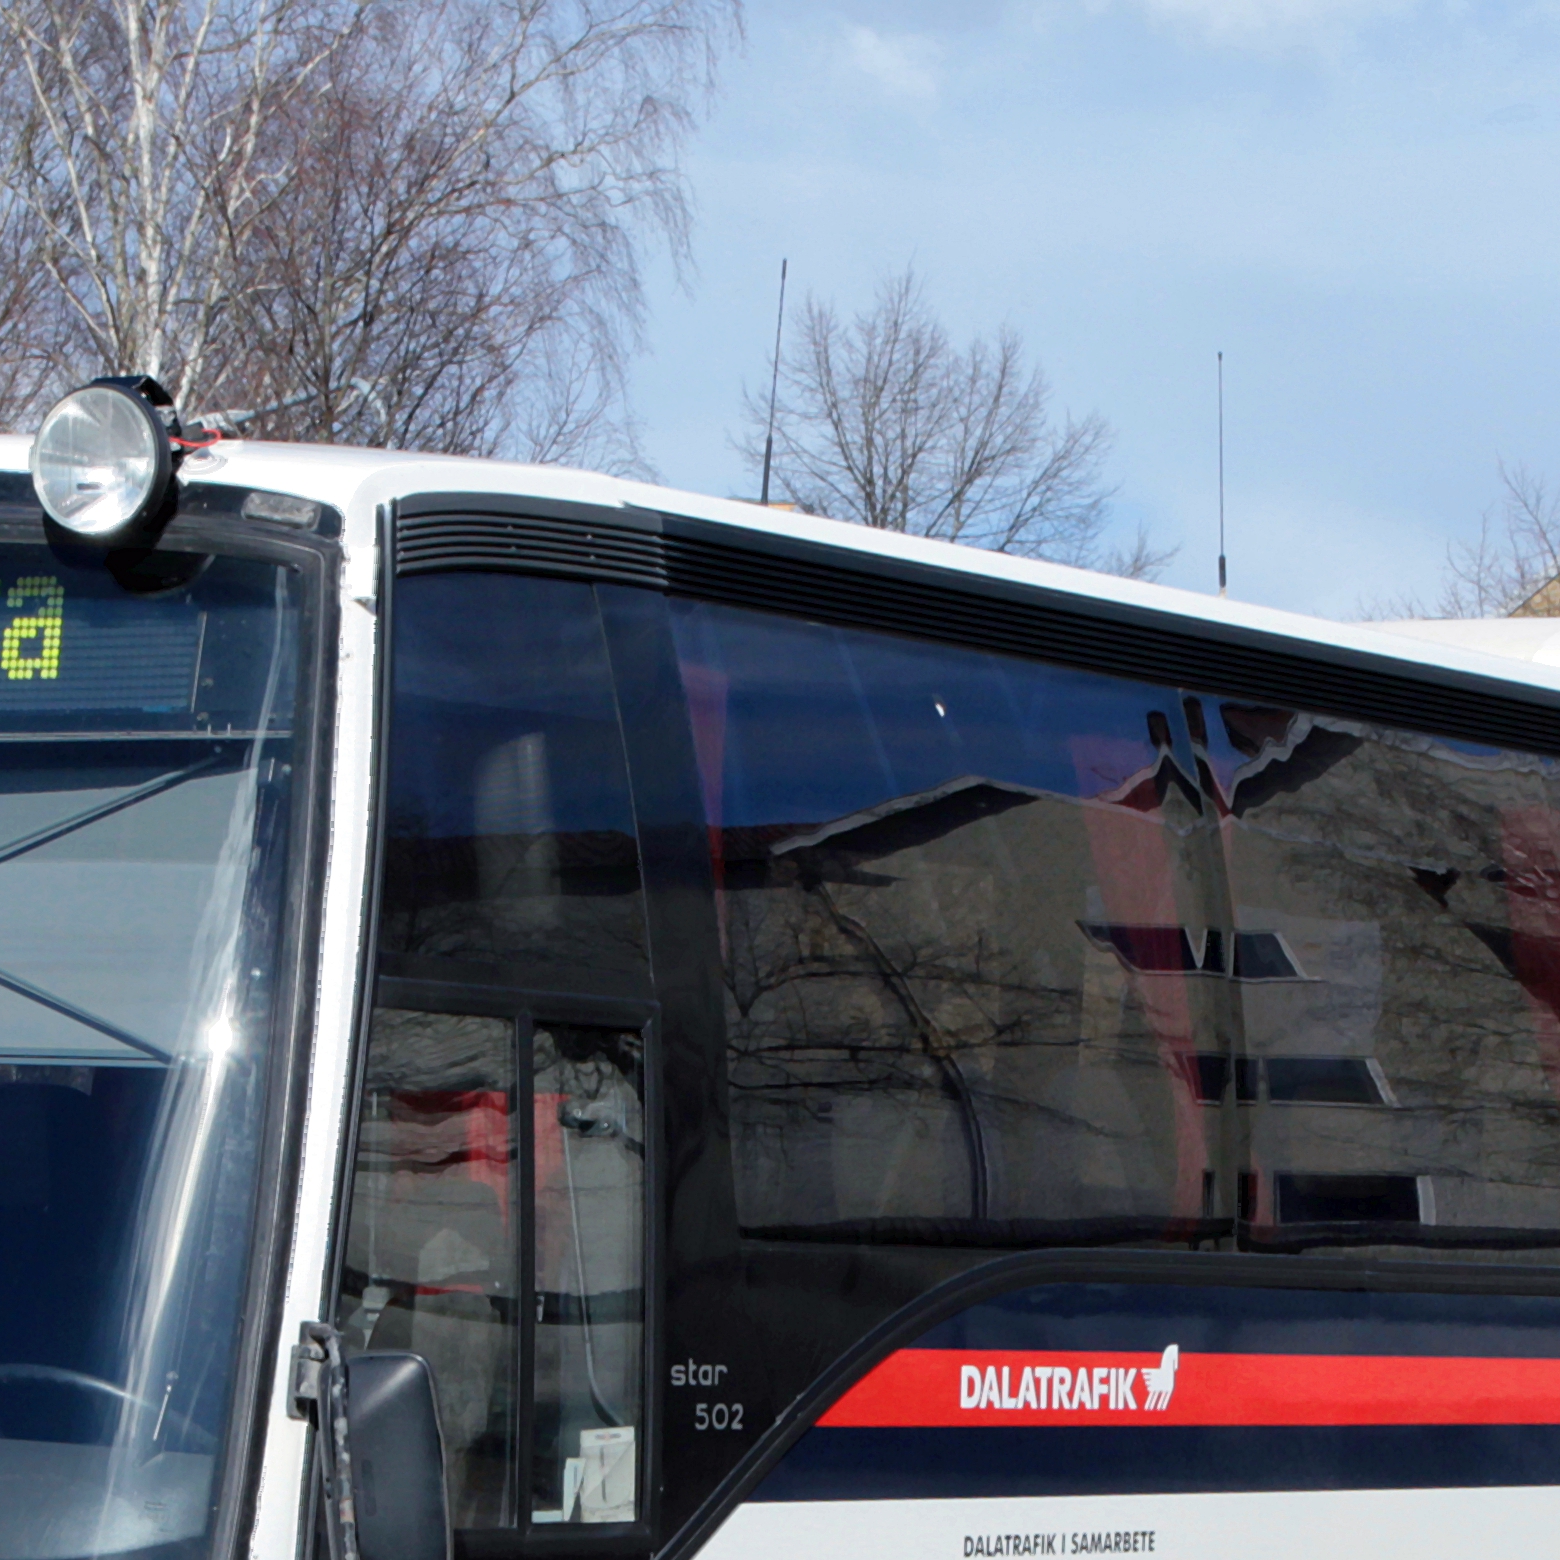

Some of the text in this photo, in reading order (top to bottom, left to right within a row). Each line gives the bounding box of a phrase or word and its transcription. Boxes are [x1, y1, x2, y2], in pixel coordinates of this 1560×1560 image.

[670, 1358, 728, 1386] star
[959, 1364, 1138, 1411] DALATRAFIK
[694, 1402, 744, 1430] 502
[963, 1530, 1156, 1557] DALATRAFIK I SAMARBETE
